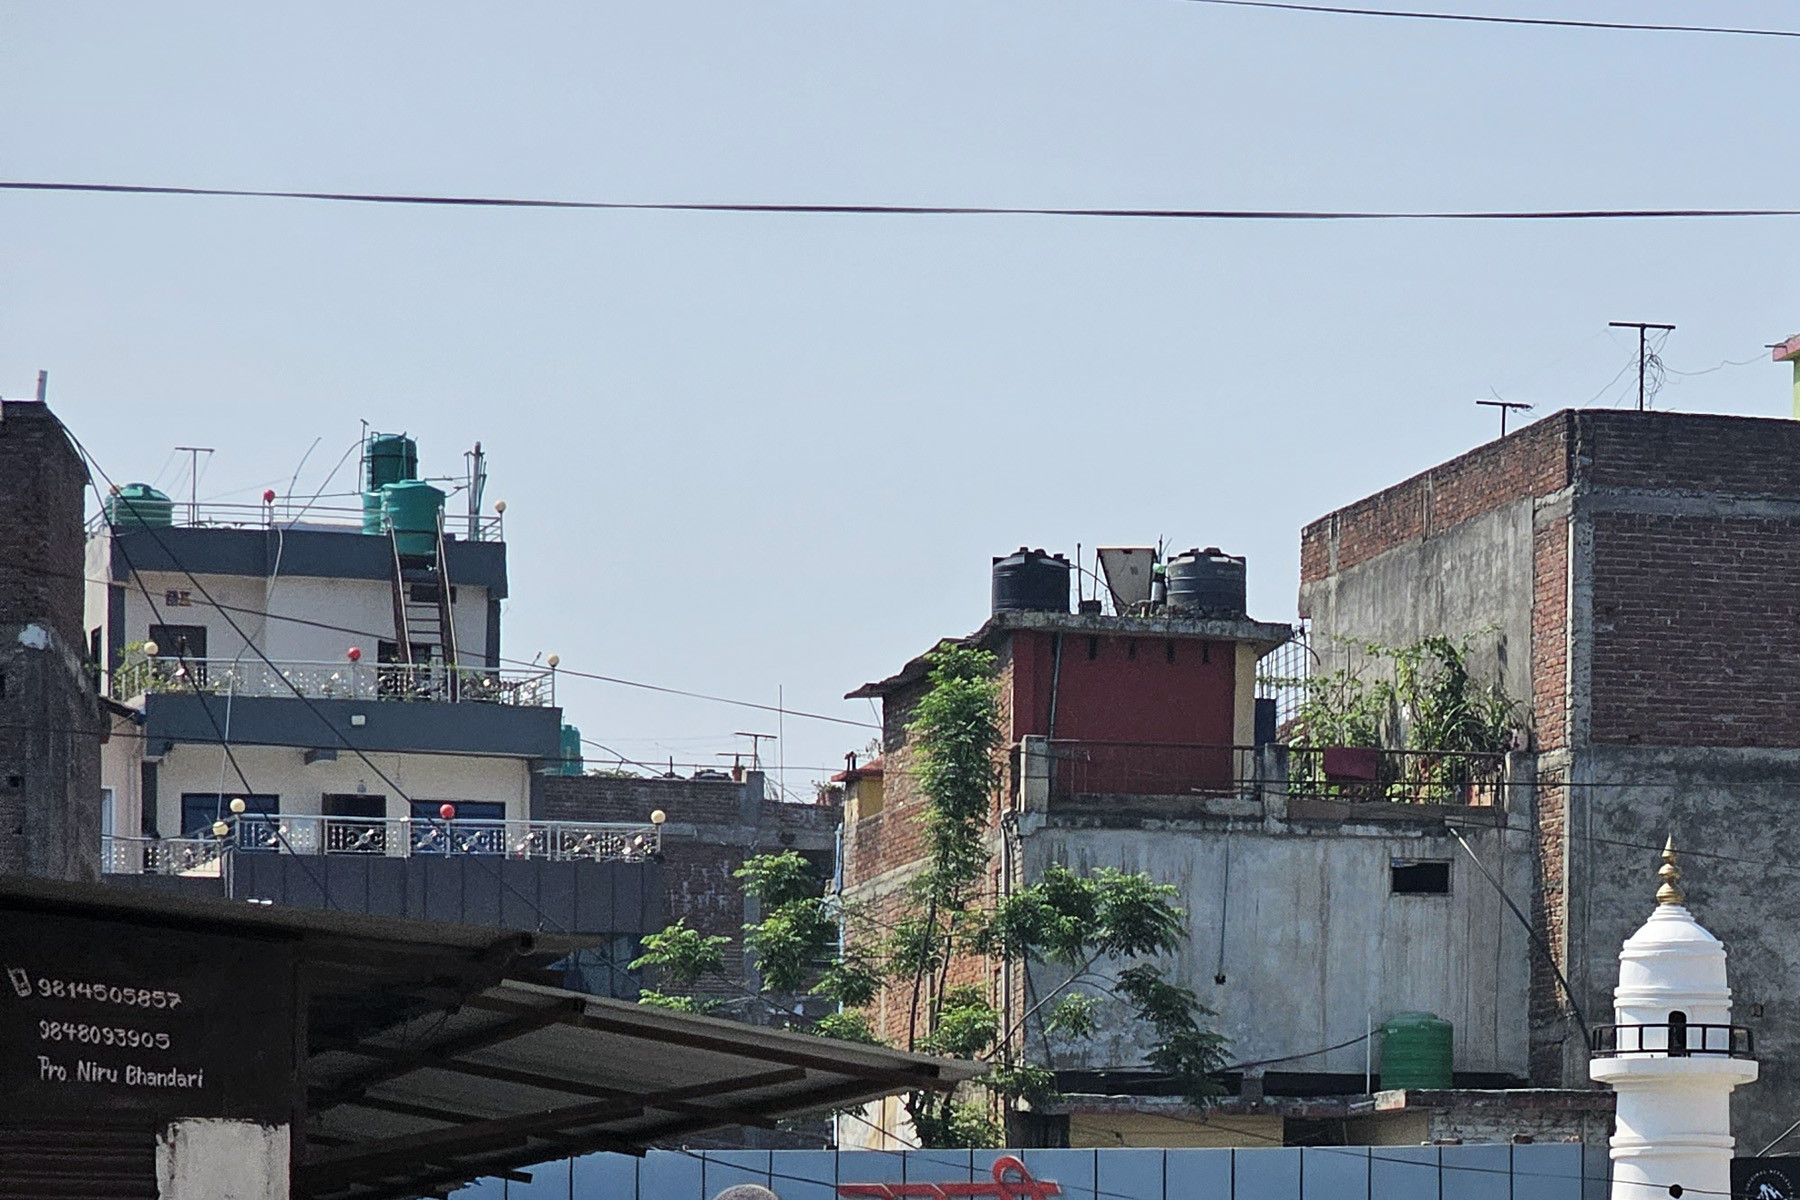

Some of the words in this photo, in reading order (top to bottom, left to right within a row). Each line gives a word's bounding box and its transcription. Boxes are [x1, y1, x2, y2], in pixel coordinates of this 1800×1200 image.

[37, 977, 183, 1009] 9814505857
[38, 1019, 171, 1050] 9848093905
[76, 1059, 118, 1083] Niru
[125, 1064, 204, 1088] Bhandari
